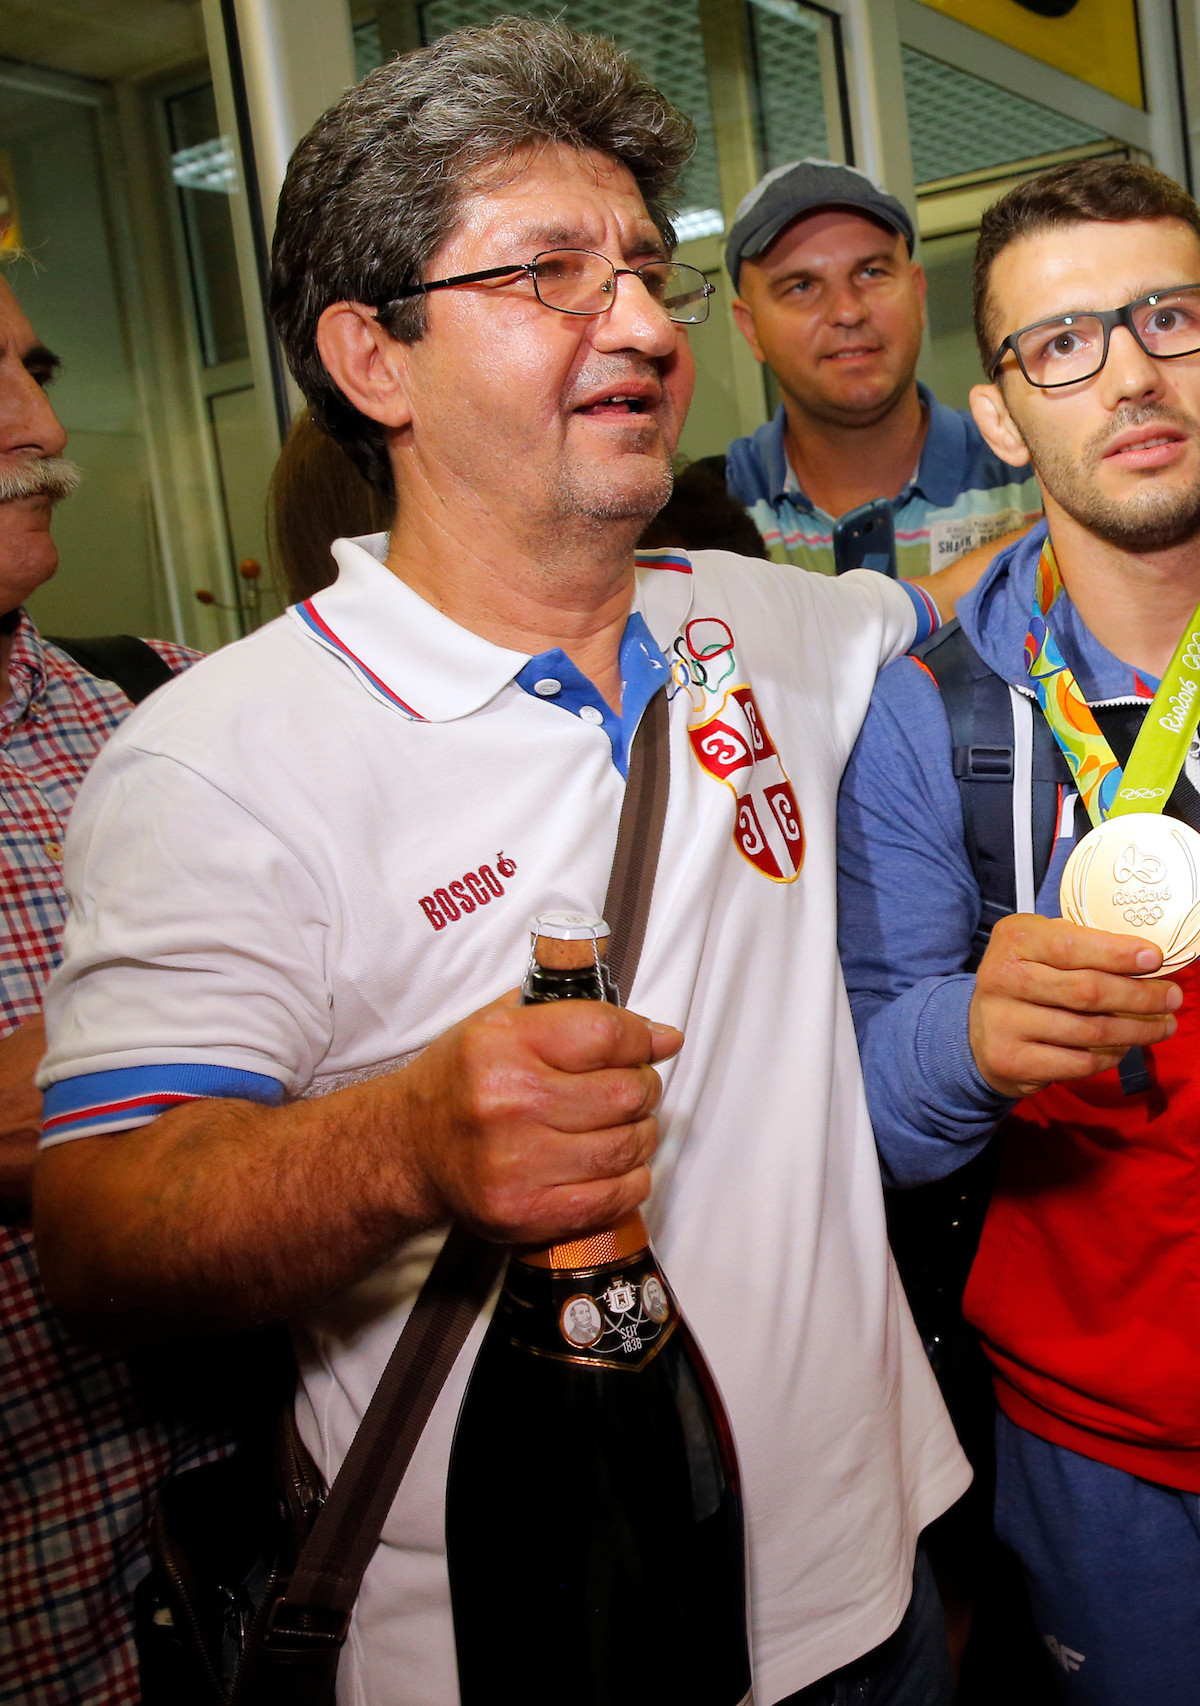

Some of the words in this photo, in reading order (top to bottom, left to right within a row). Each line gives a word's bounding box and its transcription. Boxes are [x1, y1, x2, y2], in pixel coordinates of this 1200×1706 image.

[1159, 676, 1199, 733] Rio2016
[418, 864, 505, 931] BOSCO
[620, 1323, 638, 1340] SEIT
[622, 1337, 643, 1354] 1838
